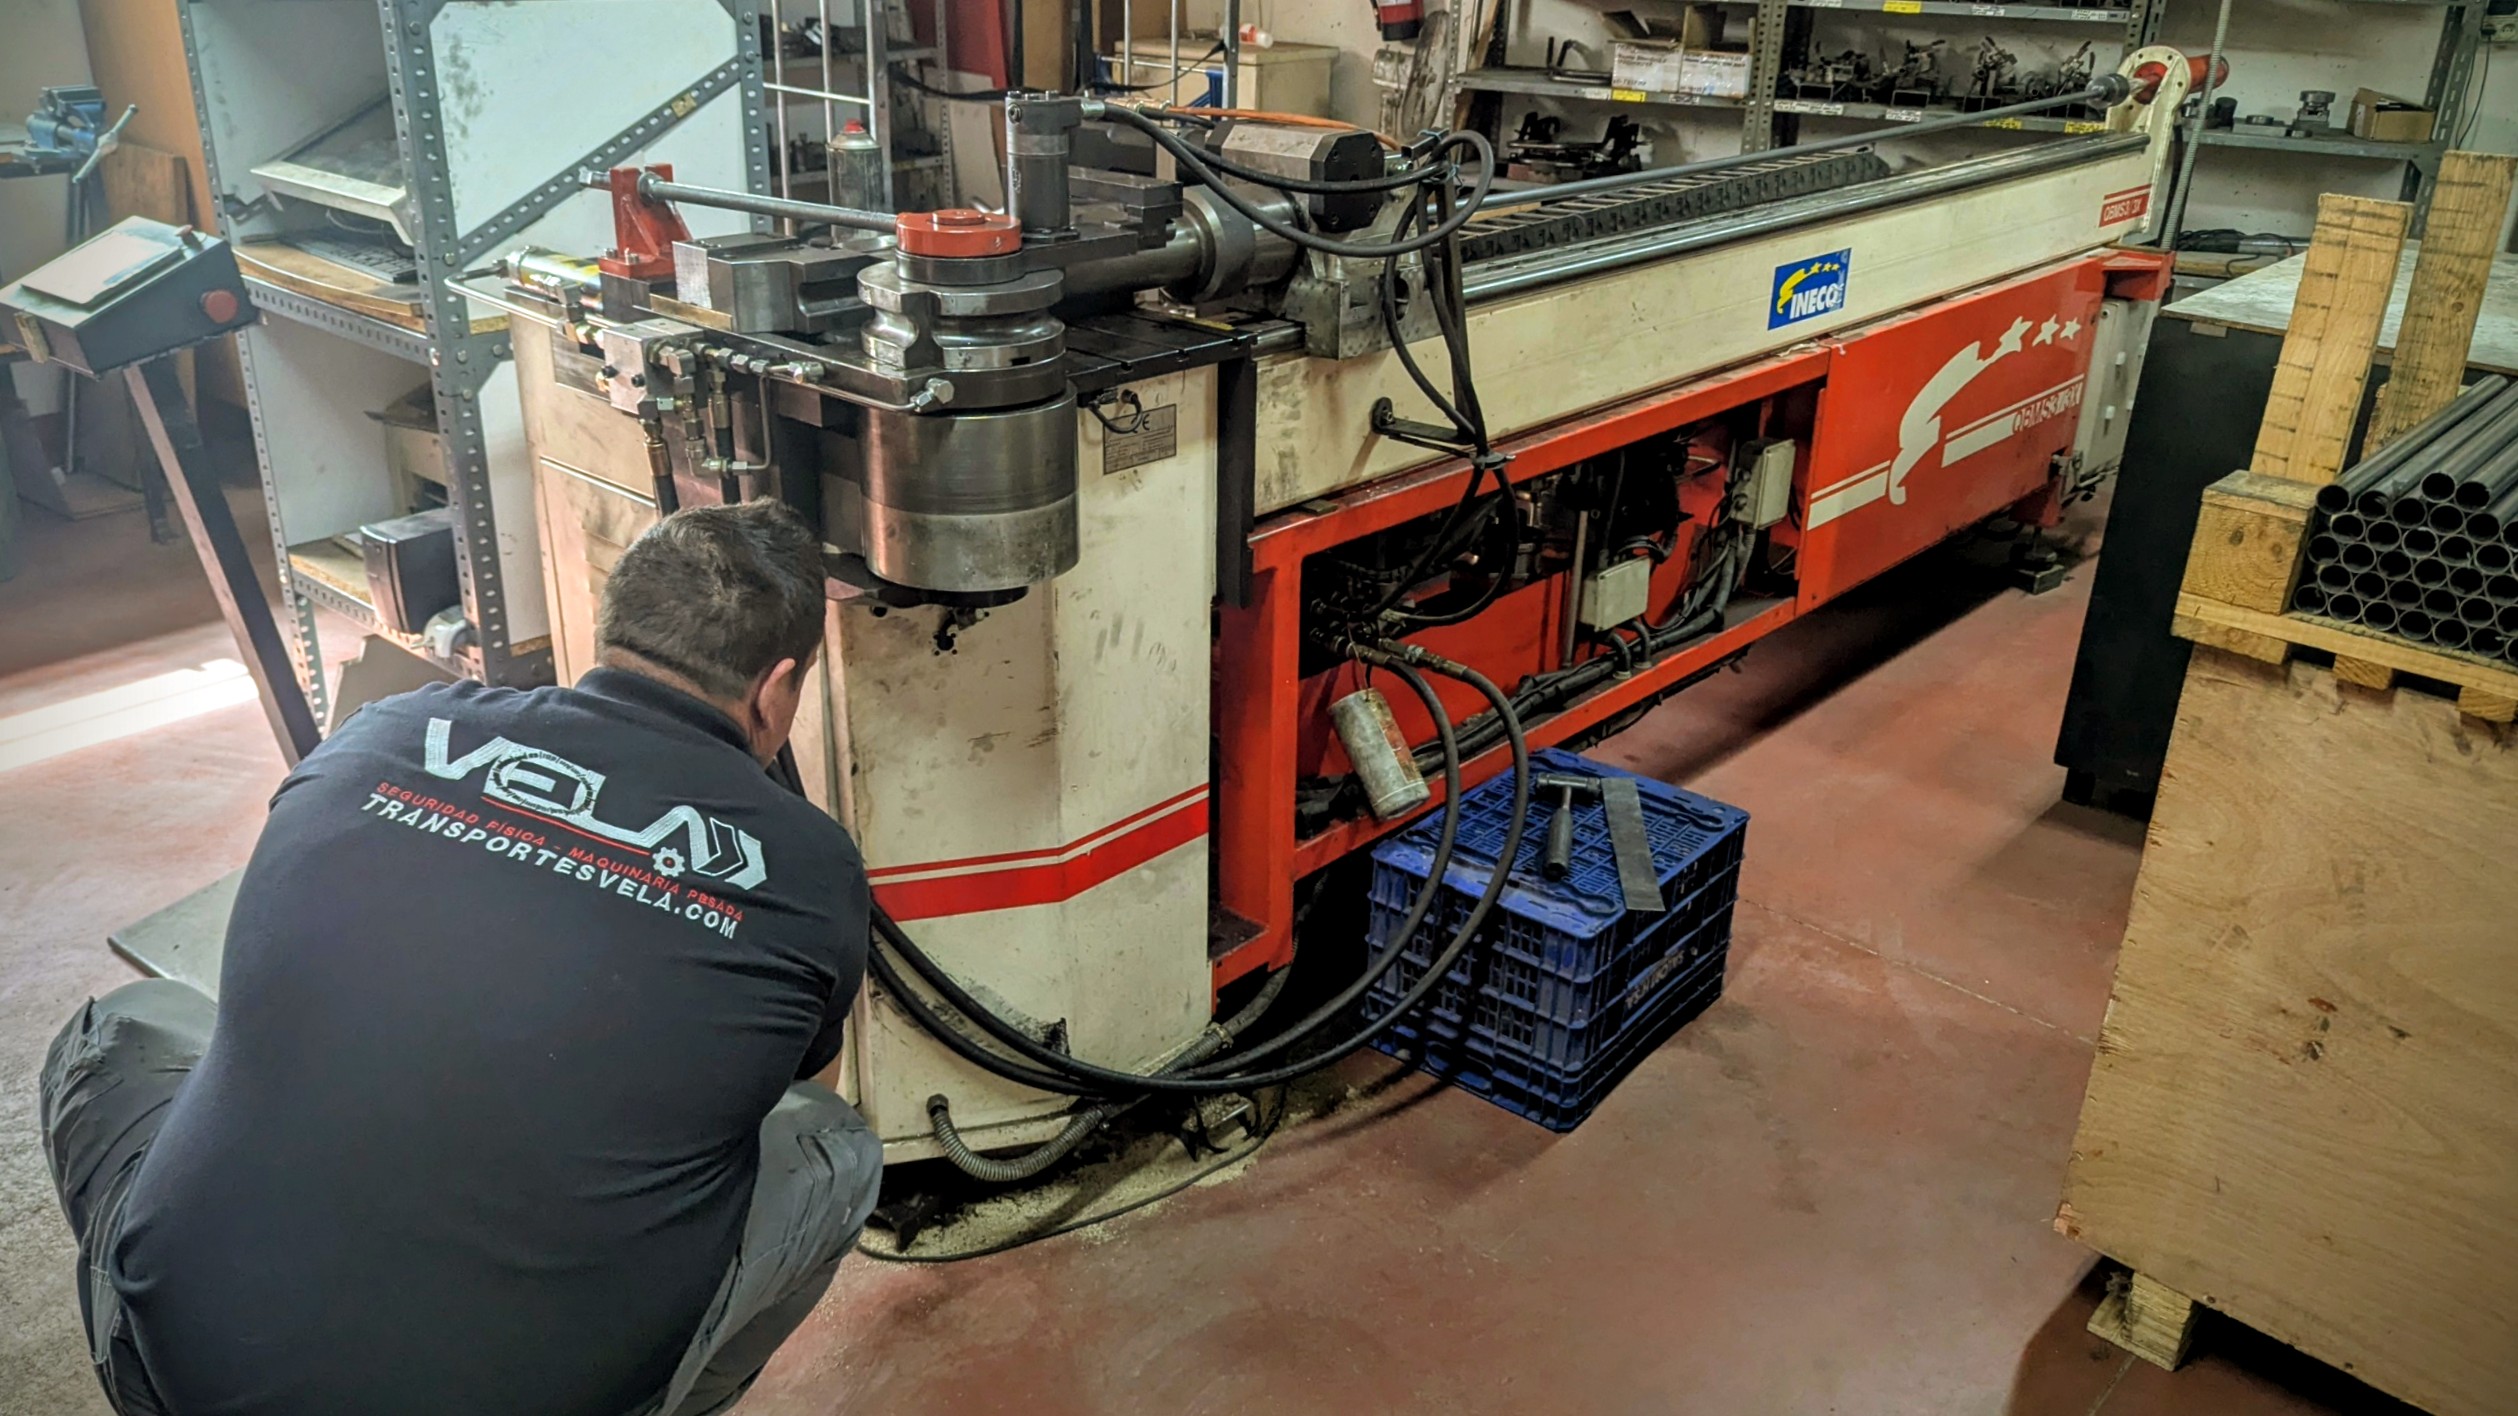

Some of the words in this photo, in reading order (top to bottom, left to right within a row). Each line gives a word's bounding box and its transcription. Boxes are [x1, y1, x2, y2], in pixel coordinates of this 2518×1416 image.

[360, 793, 739, 940] TRANSPORTESVELA.COM
[376, 781, 480, 825] SEGURIDAD
[568, 846, 681, 895] MAQUINARIA
[686, 888, 744, 922] PESADA
[425, 717, 745, 878] VELA
